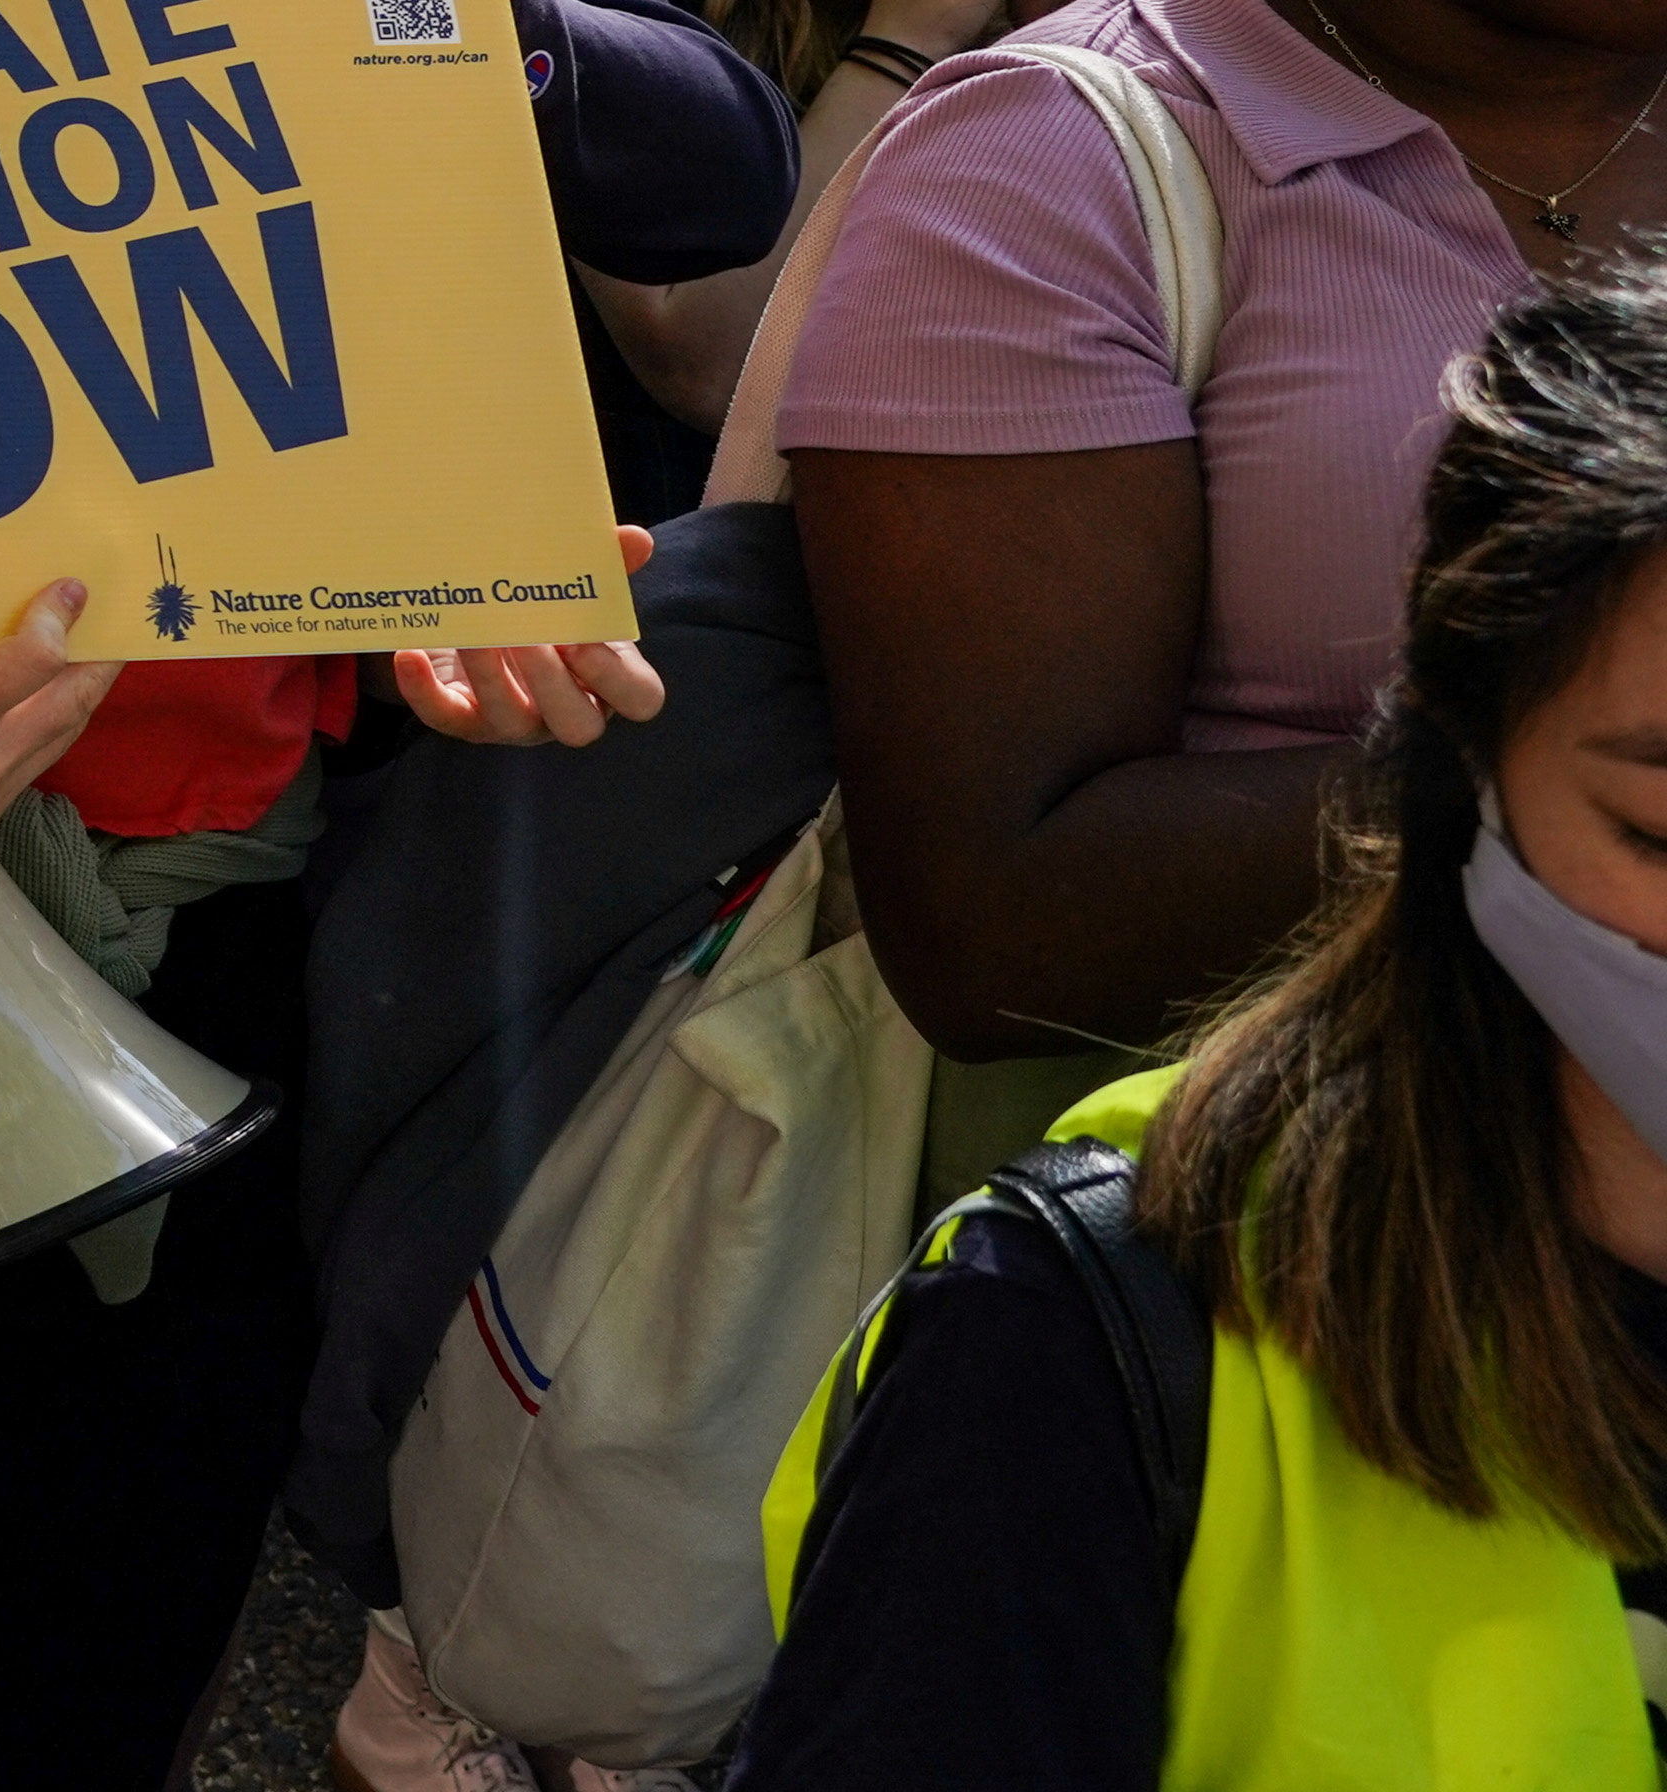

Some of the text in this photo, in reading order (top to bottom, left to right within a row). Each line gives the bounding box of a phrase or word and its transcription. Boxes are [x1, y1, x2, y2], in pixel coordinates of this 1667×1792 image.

[353, 50, 489, 67] nature.org.au/can
[209, 574, 599, 614] Nature Conservation Council
[215, 611, 441, 636] The voice for nature in NSW
